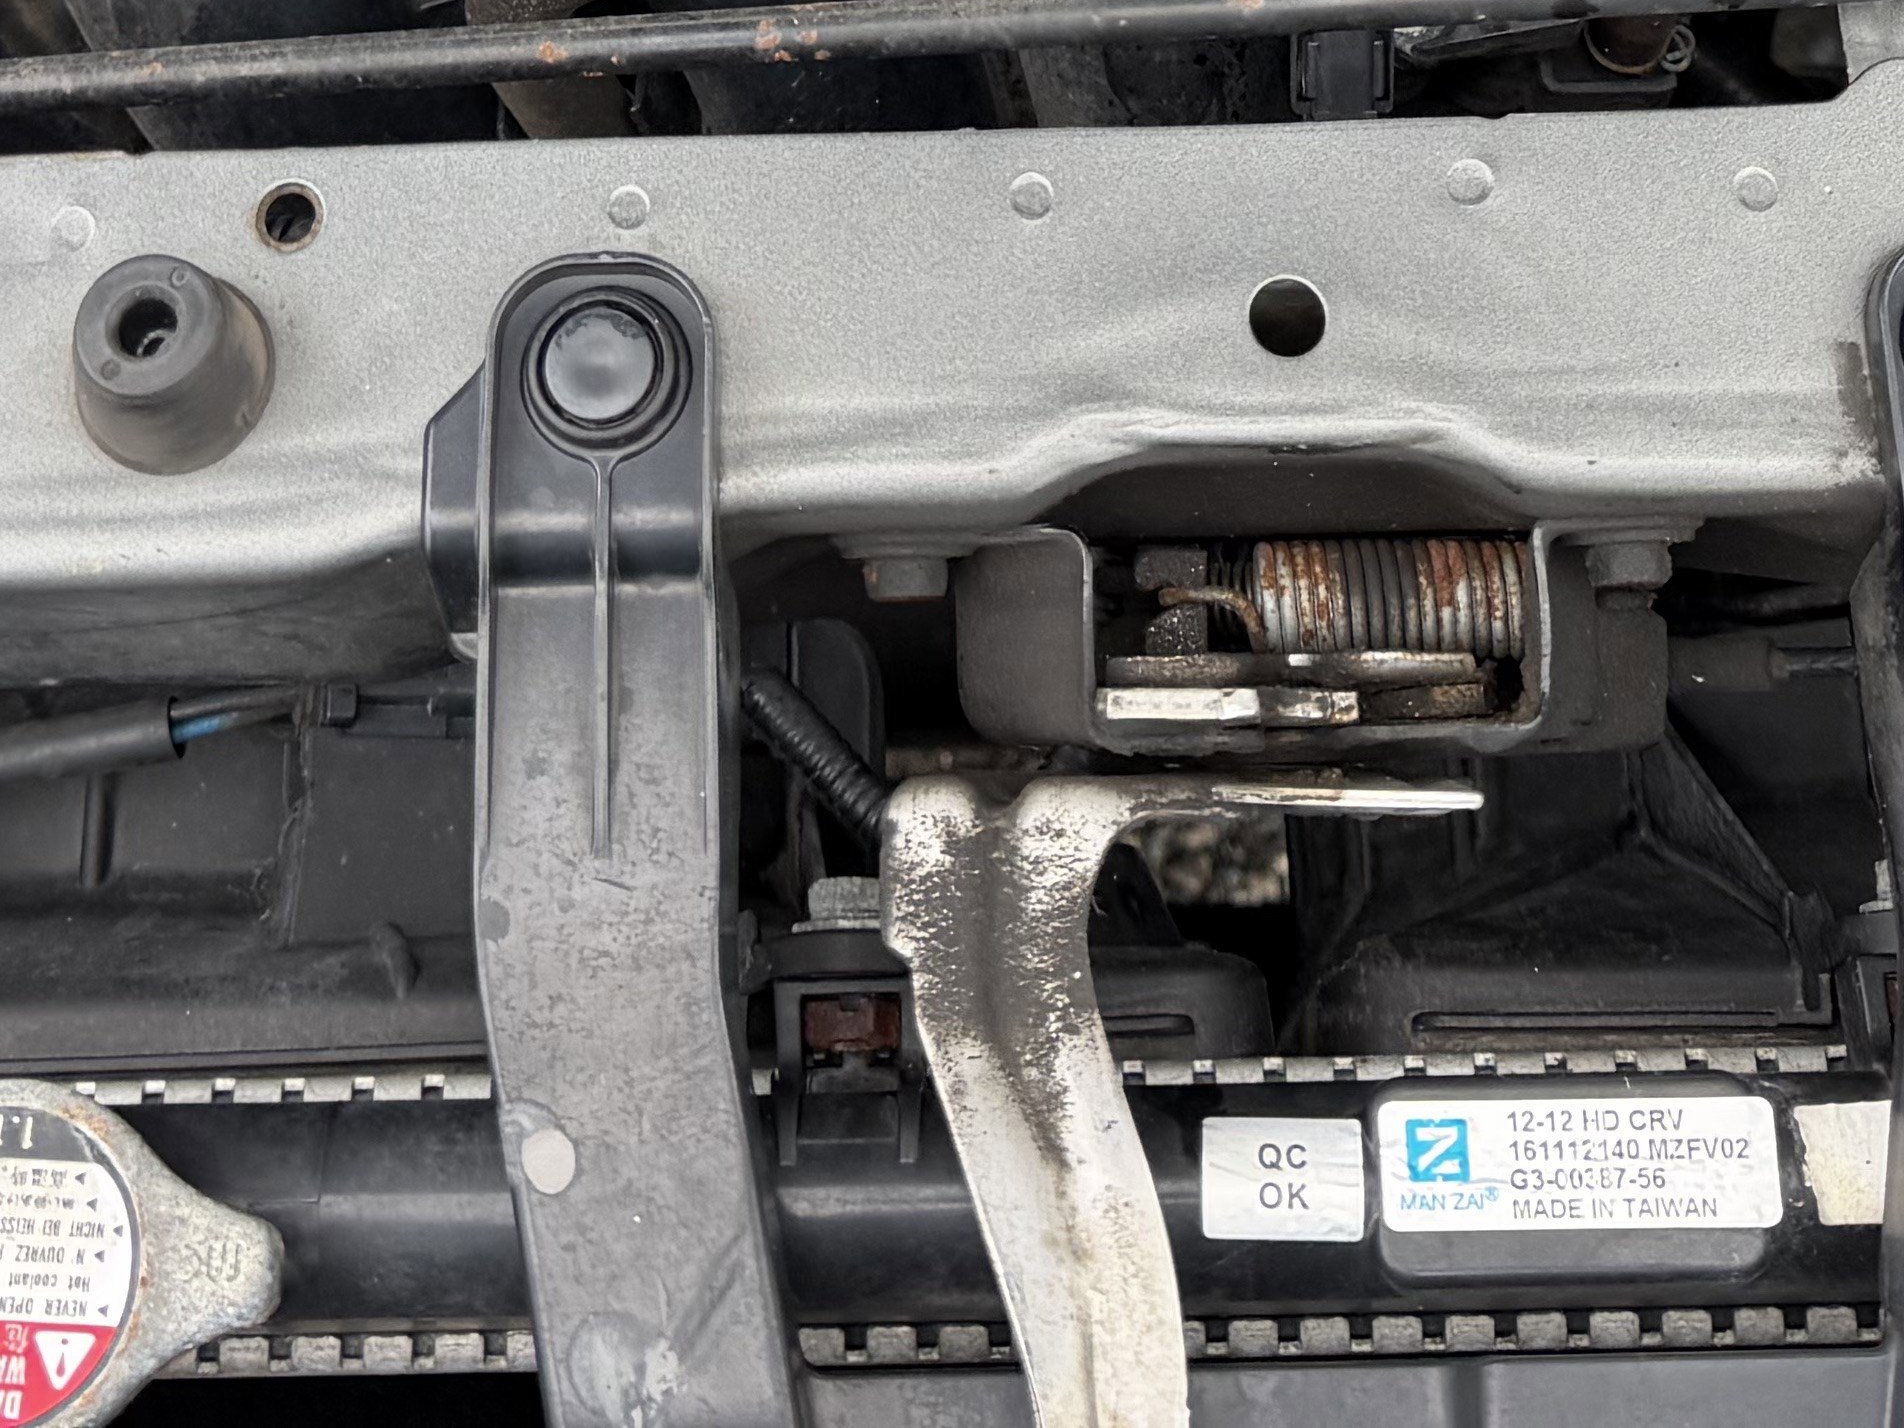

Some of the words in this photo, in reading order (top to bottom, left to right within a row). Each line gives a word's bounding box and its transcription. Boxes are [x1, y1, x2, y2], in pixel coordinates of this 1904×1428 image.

[1507, 1110, 1572, 1132] 12-12
[1582, 1109, 1619, 1131] HD
[1628, 1108, 1683, 1131] CRV
[1258, 1142, 1307, 1171] QC
[1648, 1138, 1750, 1160] MZFV02
[1259, 1181, 1310, 1210] OK
[1512, 1198, 1585, 1220] MADE
[1592, 1198, 1614, 1218] IN
[1622, 1197, 1718, 1218] TAIWAN
[41, 1221, 60, 1237] BEI
[69, 1222, 105, 1240] NICHT
[14, 1244, 65, 1264] OUVREZ
[8, 1272, 58, 1291] coolant
[67, 1275, 91, 1294] Hot
[45, 1300, 87, 1317] NEVER
